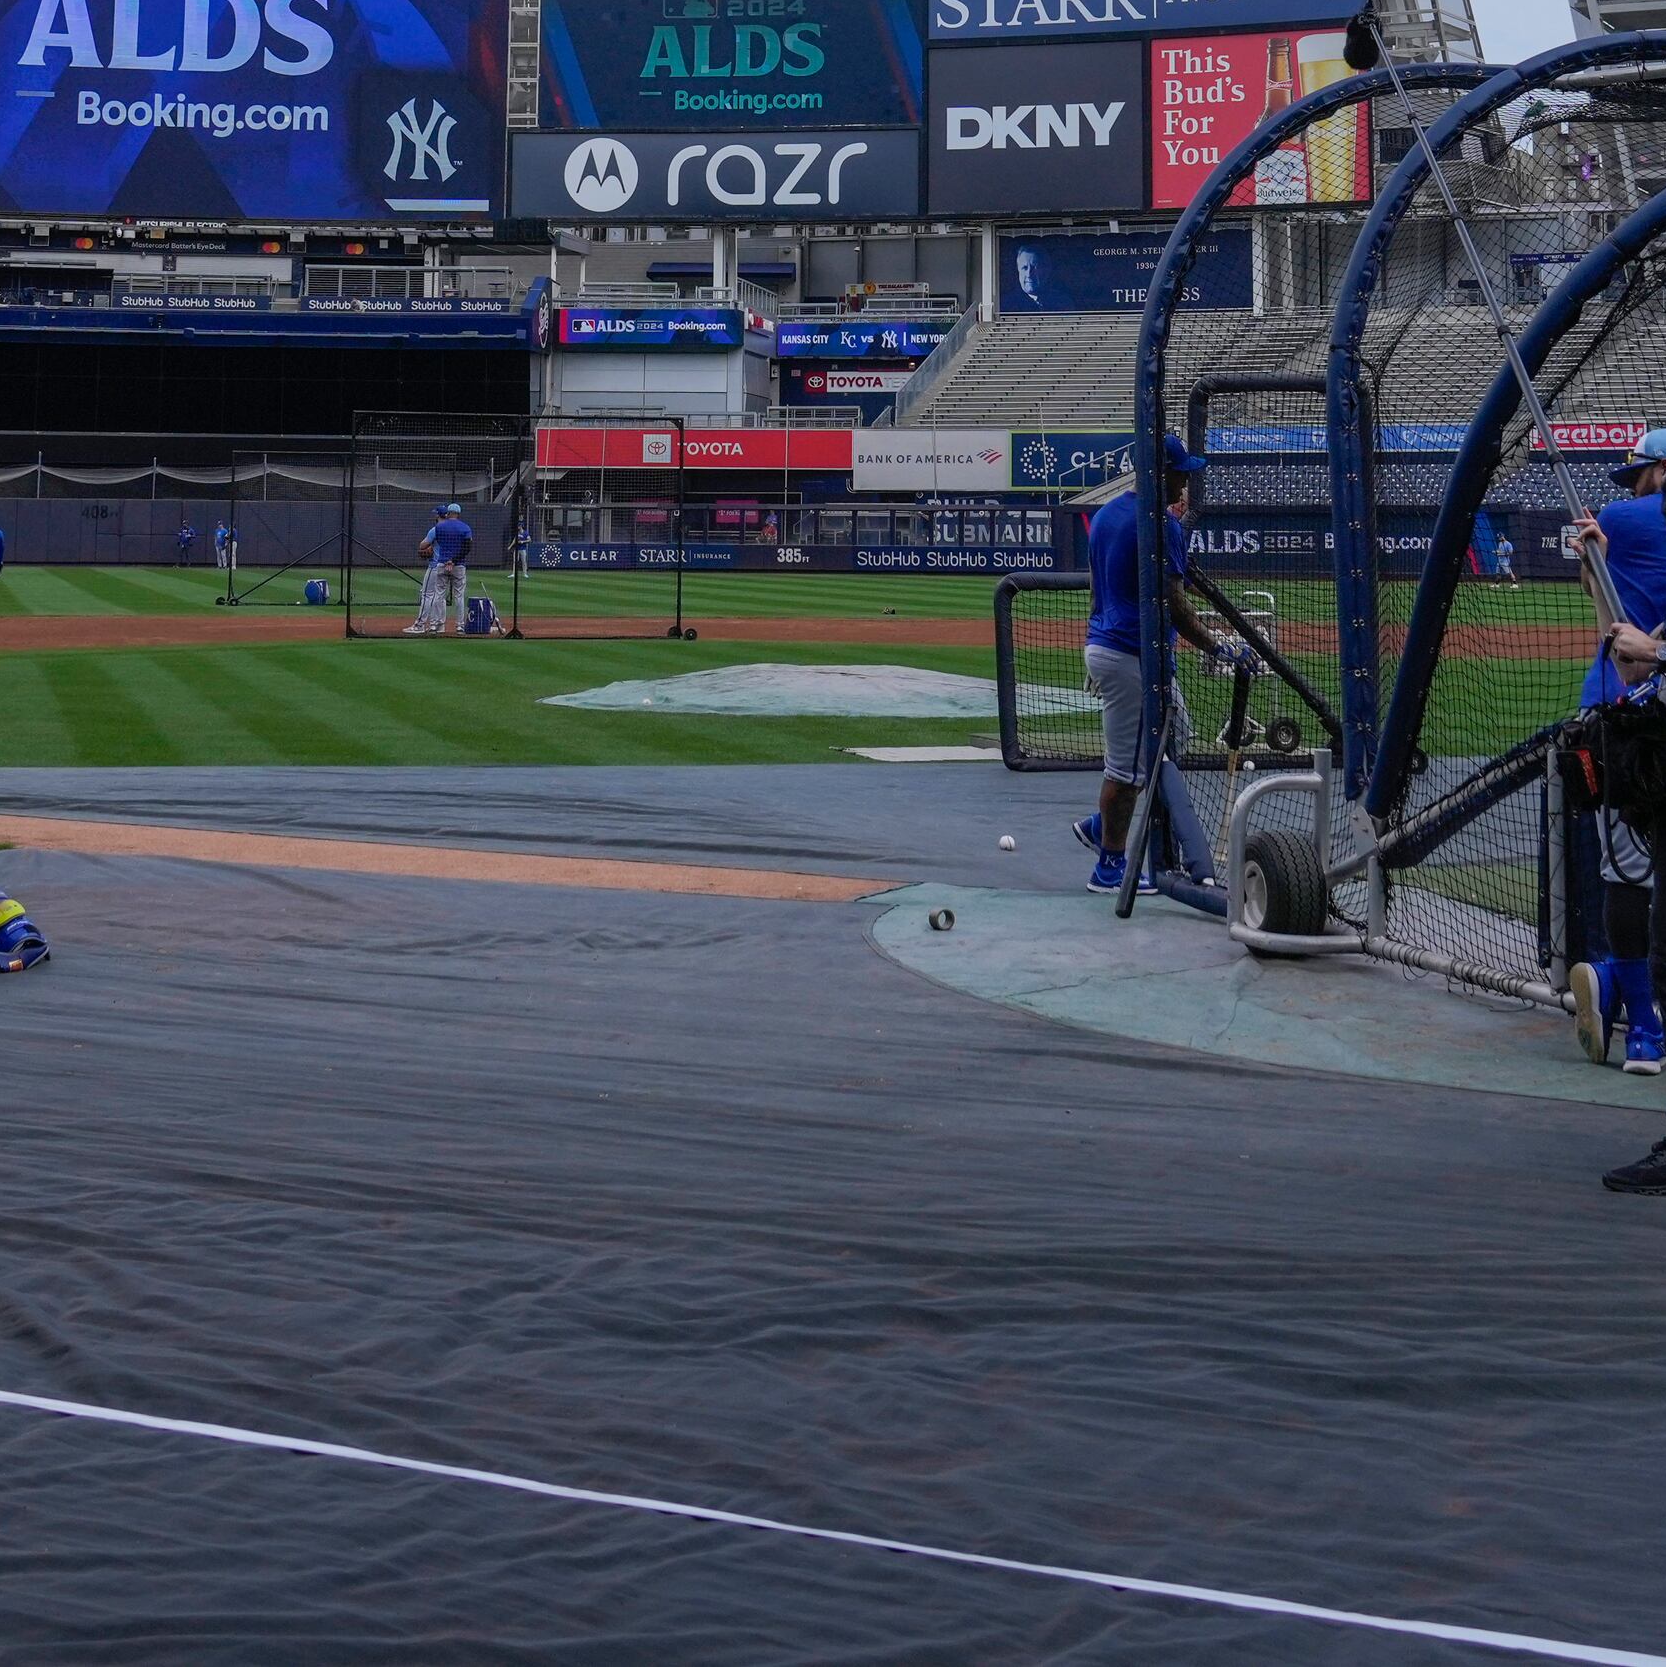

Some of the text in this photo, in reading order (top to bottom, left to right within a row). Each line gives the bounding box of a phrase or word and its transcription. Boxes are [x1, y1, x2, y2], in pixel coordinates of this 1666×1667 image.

[727, 0, 806, 16] 2024
[639, 23, 825, 78] ALDS
[1162, 49, 1231, 76] This
[1163, 77, 1245, 106] Bud's
[675, 89, 822, 114] Booking.com
[76, 90, 328, 138] Booking.com
[947, 102, 1125, 150] DKNY
[1164, 111, 1214, 135] For
[1162, 141, 1221, 166] You
[668, 143, 867, 206] razr
[1113, 289, 1147, 302] THE
[122, 296, 502, 312] StubHub StubHub StubHub StubHub StubHub StubHub
[596, 319, 726, 333] ALDS 2024 Booking.com
[782, 335, 808, 345] KANSAS
[810, 335, 829, 345] CITY
[911, 335, 928, 345] NEW
[829, 376, 882, 388] TOYOTA
[677, 442, 743, 456] TOYOTA
[858, 454, 974, 464] BANK OF AMERICA
[1188, 530, 1314, 554] ALDS 2024
[1541, 537, 1557, 548] THE
[570, 550, 617, 562] CLEAR
[639, 550, 686, 563] STARR
[858, 551, 1053, 567] StubHub StubHub StubHub
